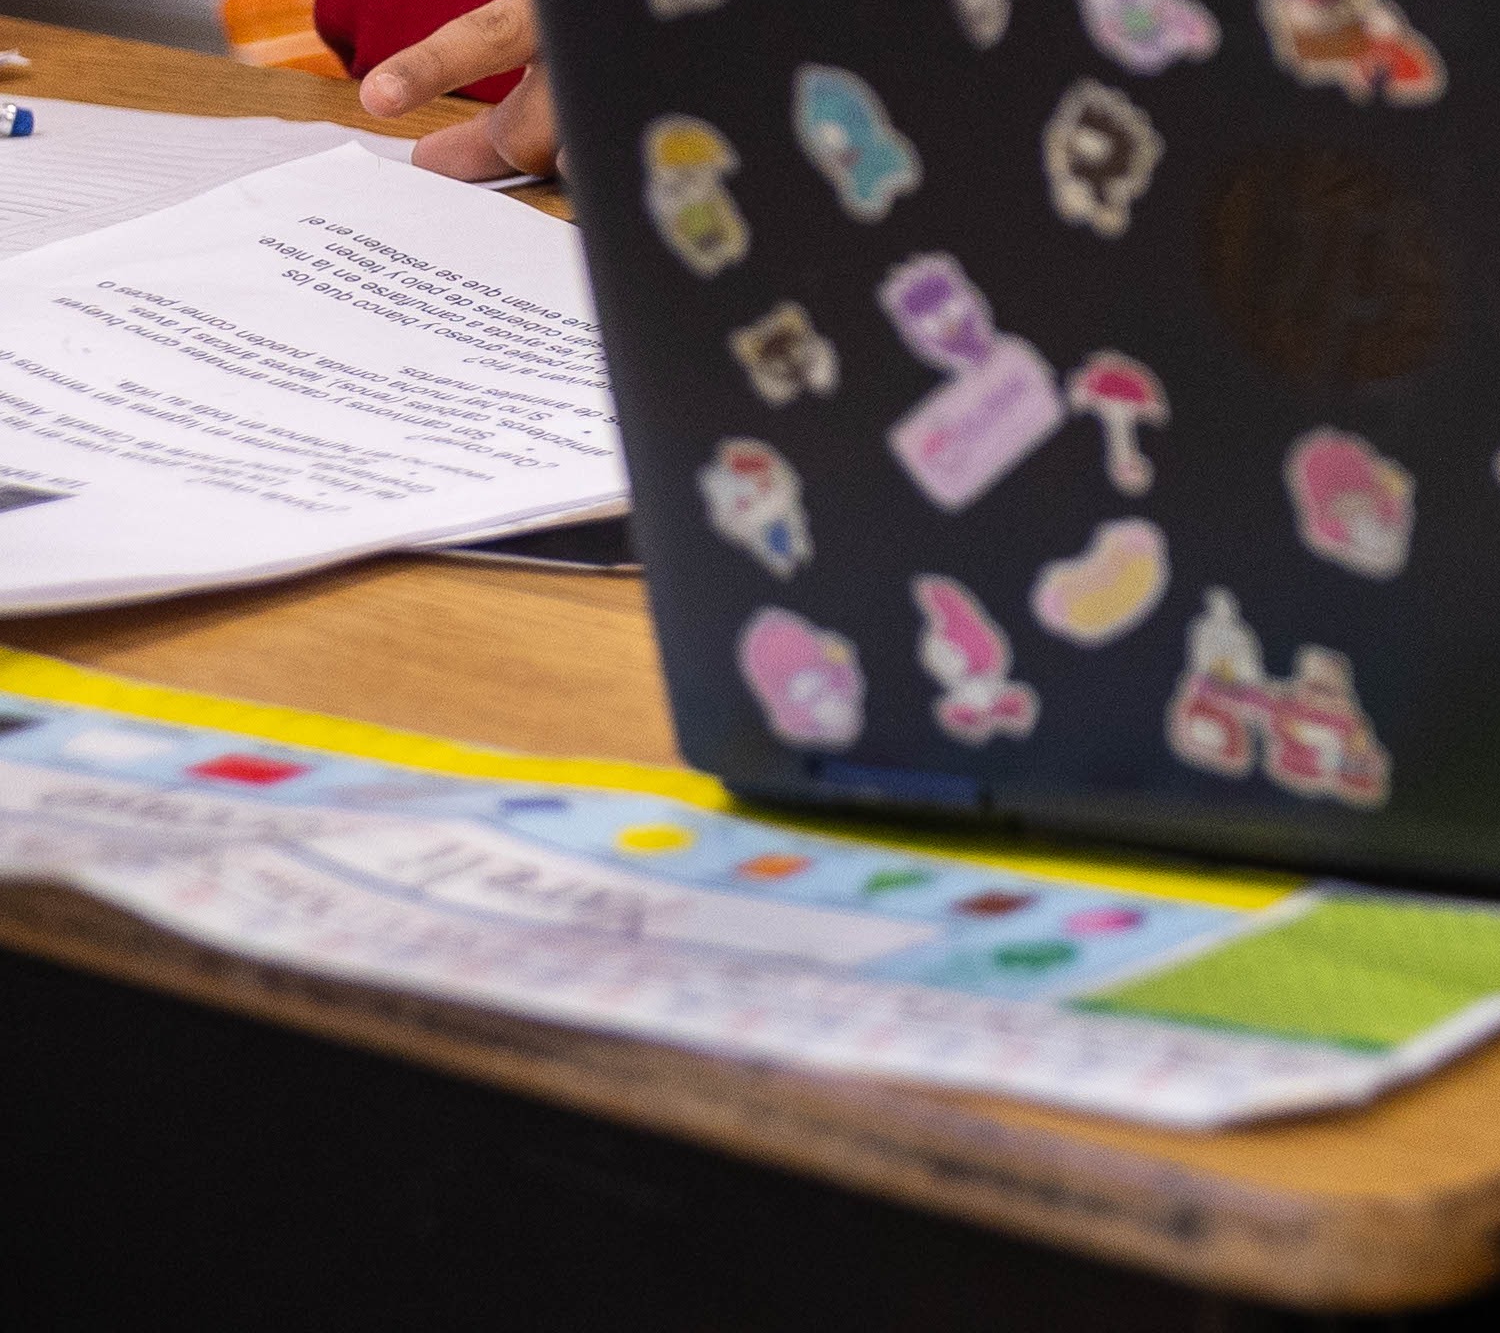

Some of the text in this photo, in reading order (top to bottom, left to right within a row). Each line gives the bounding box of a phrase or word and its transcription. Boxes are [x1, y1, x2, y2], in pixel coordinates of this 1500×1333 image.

[324, 223, 354, 236] en
[324, 242, 387, 275] tienen
[352, 234, 437, 273] resbalen
[311, 259, 336, 272] la
[281, 269, 316, 287] los
[332, 268, 363, 284] en
[382, 270, 409, 280] y
[435, 270, 463, 283] se
[97, 281, 117, 289] o
[313, 282, 353, 302] que
[399, 276, 452, 296] pelo
[461, 280, 502, 298] que
[114, 286, 182, 307] peces
[361, 282, 468, 323] camuflarse
[444, 293, 474, 308] de
[53, 297, 127, 327] bueyes
[352, 300, 420, 327] blanco
[500, 295, 563, 320] evitan
[171, 305, 237, 332] comer
[416, 322, 441, 331] y
[465, 320, 485, 329] a
[472, 304, 563, 338] cubiertas
[174, 326, 201, 335] y
[483, 325, 547, 348] ayuda
[235, 330, 318, 359] pueden
[434, 328, 509, 352] grueso
[502, 349, 571, 368] pelaje
[544, 345, 580, 357] les
[575, 352, 602, 360] y
[179, 346, 269, 380] animales
[258, 358, 328, 383] liebres
[509, 367, 539, 375] al
[564, 364, 595, 372] un
[13, 359, 96, 393] remotos
[268, 378, 330, 399] cazan
[387, 380, 460, 402] mucha
[91, 392, 129, 406] tan
[162, 396, 192, 406] su
[326, 396, 352, 404] y
[454, 396, 500, 409] hay
[481, 388, 575, 410] animales
[126, 403, 204, 429] lugares
[190, 404, 239, 422] toda
[522, 411, 553, 422] Si
[573, 408, 604, 418] de
[201, 426, 234, 436] en
[235, 419, 268, 430] en
[452, 426, 495, 440] Son
[265, 428, 364, 453] humanos
[492, 452, 559, 468] ¿Qué
